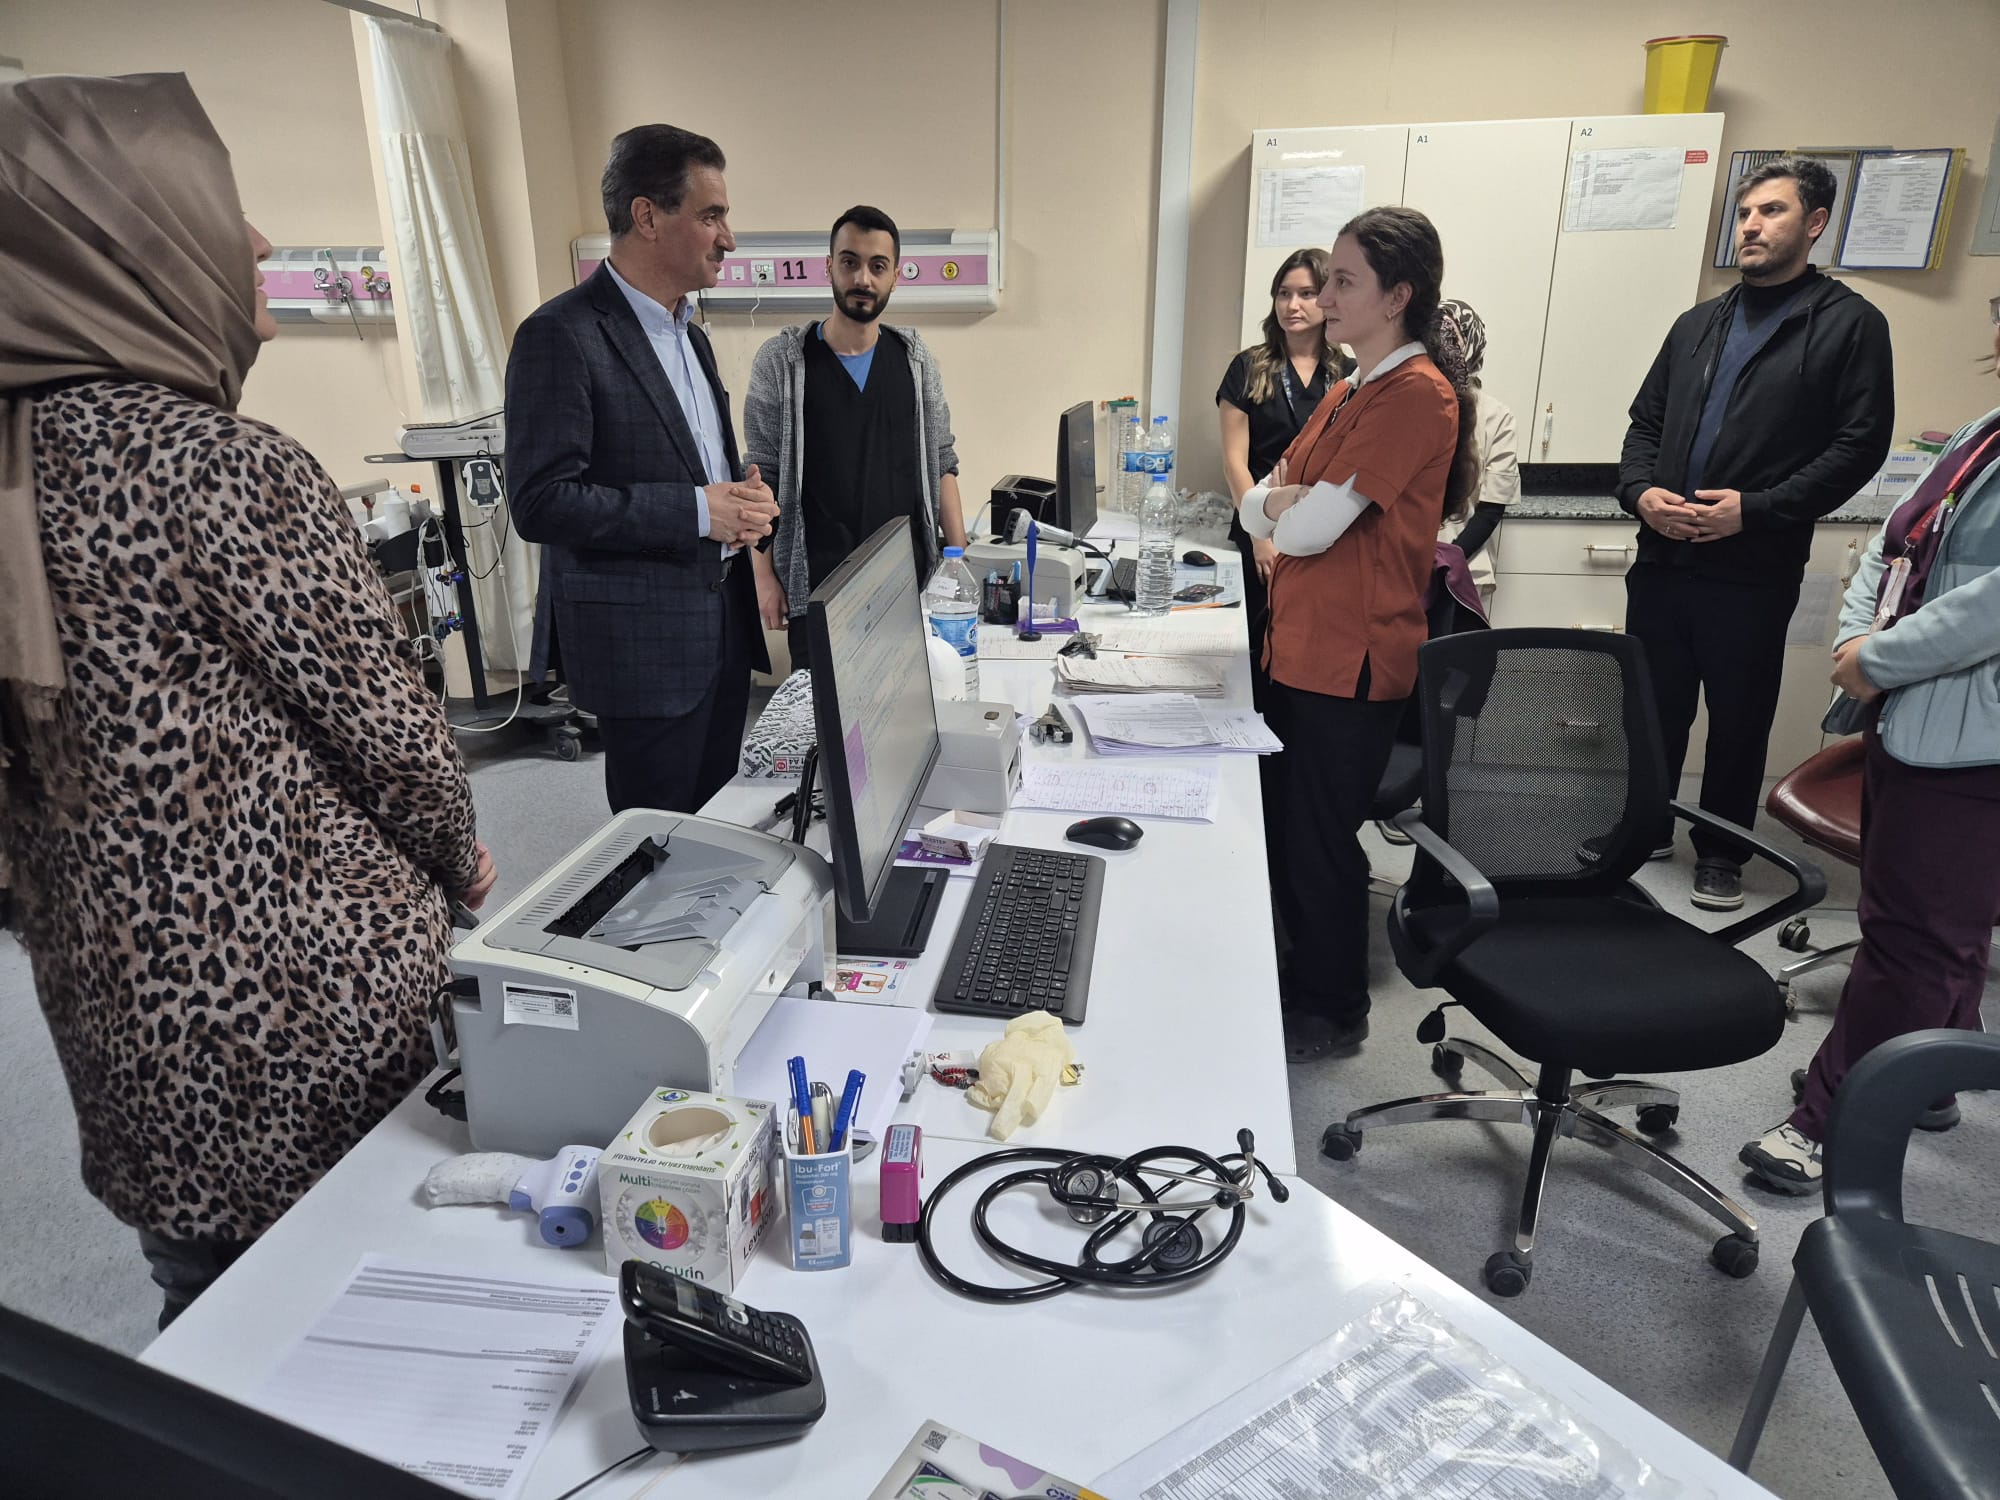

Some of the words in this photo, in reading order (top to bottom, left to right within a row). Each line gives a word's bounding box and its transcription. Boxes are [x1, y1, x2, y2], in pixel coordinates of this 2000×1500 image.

[1580, 128, 1593, 137] A2
[1266, 138, 1278, 147] A1
[1417, 135, 1428, 144] A1
[782, 260, 808, 280] 11
[619, 1173, 651, 1187] Multi
